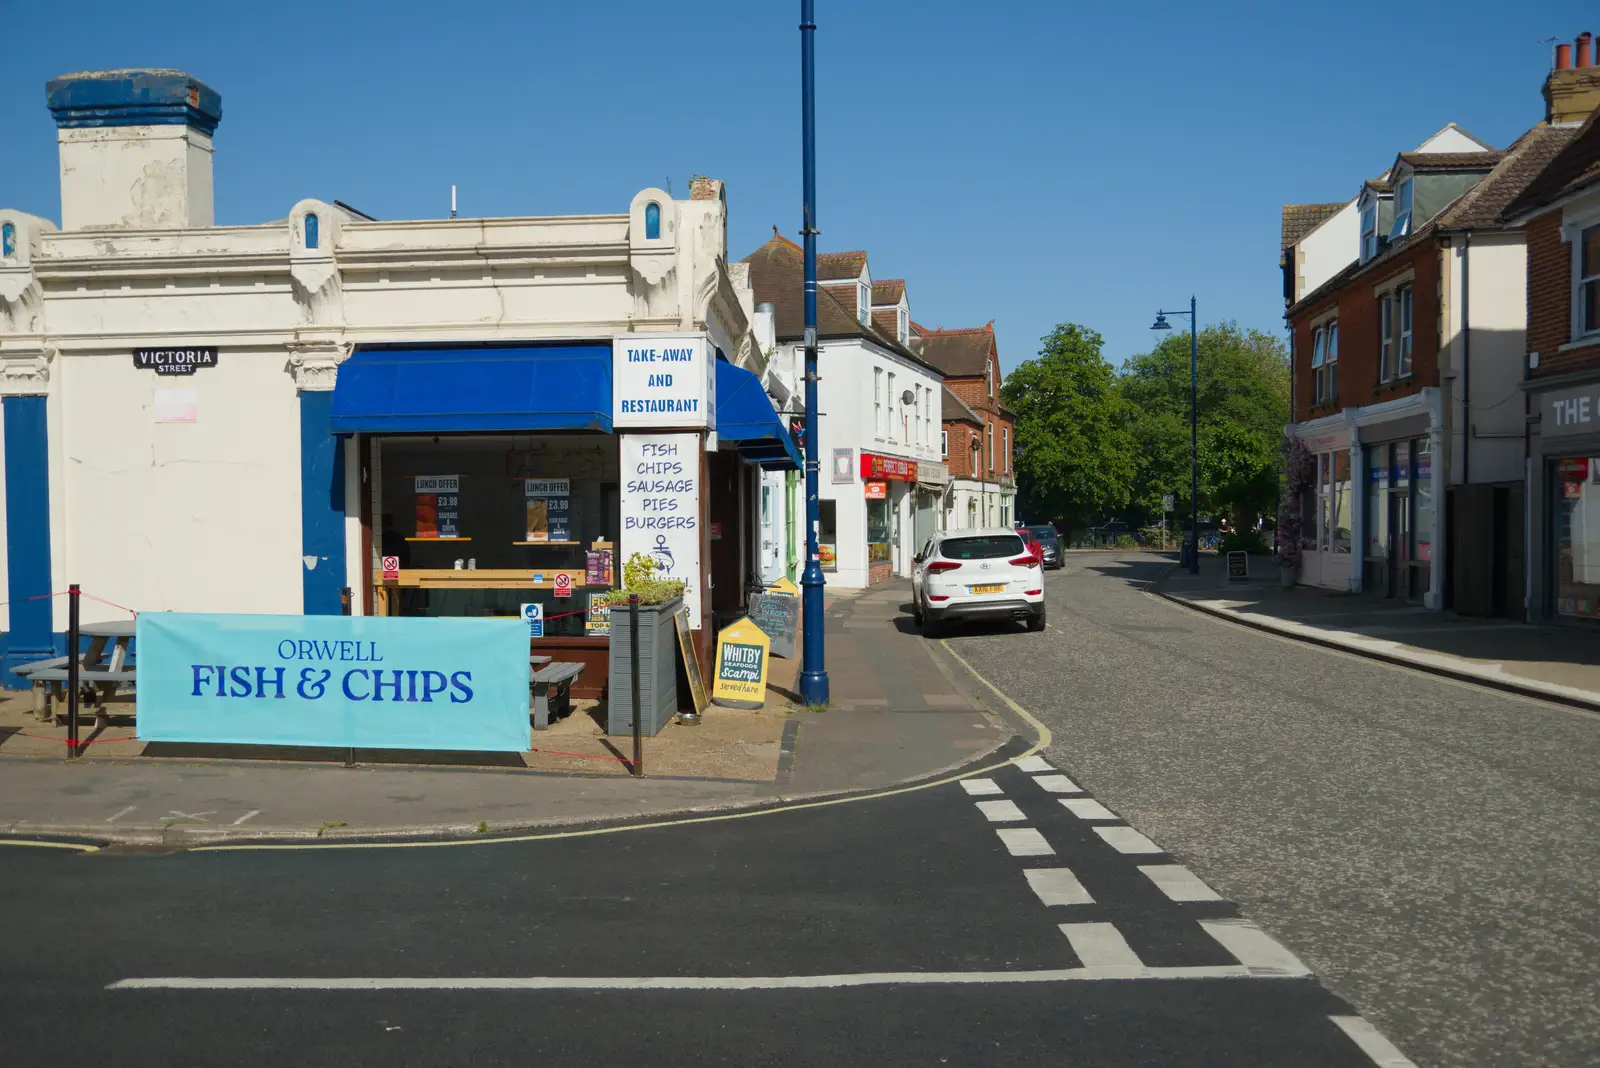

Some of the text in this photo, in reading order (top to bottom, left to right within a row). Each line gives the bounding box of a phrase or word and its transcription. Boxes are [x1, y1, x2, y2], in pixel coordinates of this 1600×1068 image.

[140, 351, 212, 364] VICTORIA
[627, 349, 693, 362] TAKE-AWAY
[648, 374, 673, 387] AND
[621, 399, 699, 413] RESTAURANT
[1552, 397, 1592, 427] THE
[642, 443, 678, 457] FISH
[636, 461, 683, 474] CHIPS
[416, 479, 458, 489] LUNCH OFFER
[527, 482, 569, 492] LUNCH OFFER
[627, 479, 694, 493] SAUSAGE
[438, 497, 458, 507] £3.99
[549, 500, 569, 510] £3.99
[643, 498, 678, 511] PIES
[625, 516, 696, 530] BURGERS
[592, 598, 608, 607] FIS
[278, 639, 383, 662] ORWELL
[723, 643, 761, 664] WHITBY
[723, 661, 758, 669] SEAFOODS
[721, 667, 760, 682] Scampi
[191, 665, 473, 703] FISH & CHIPS
[720, 682, 759, 694] served here
